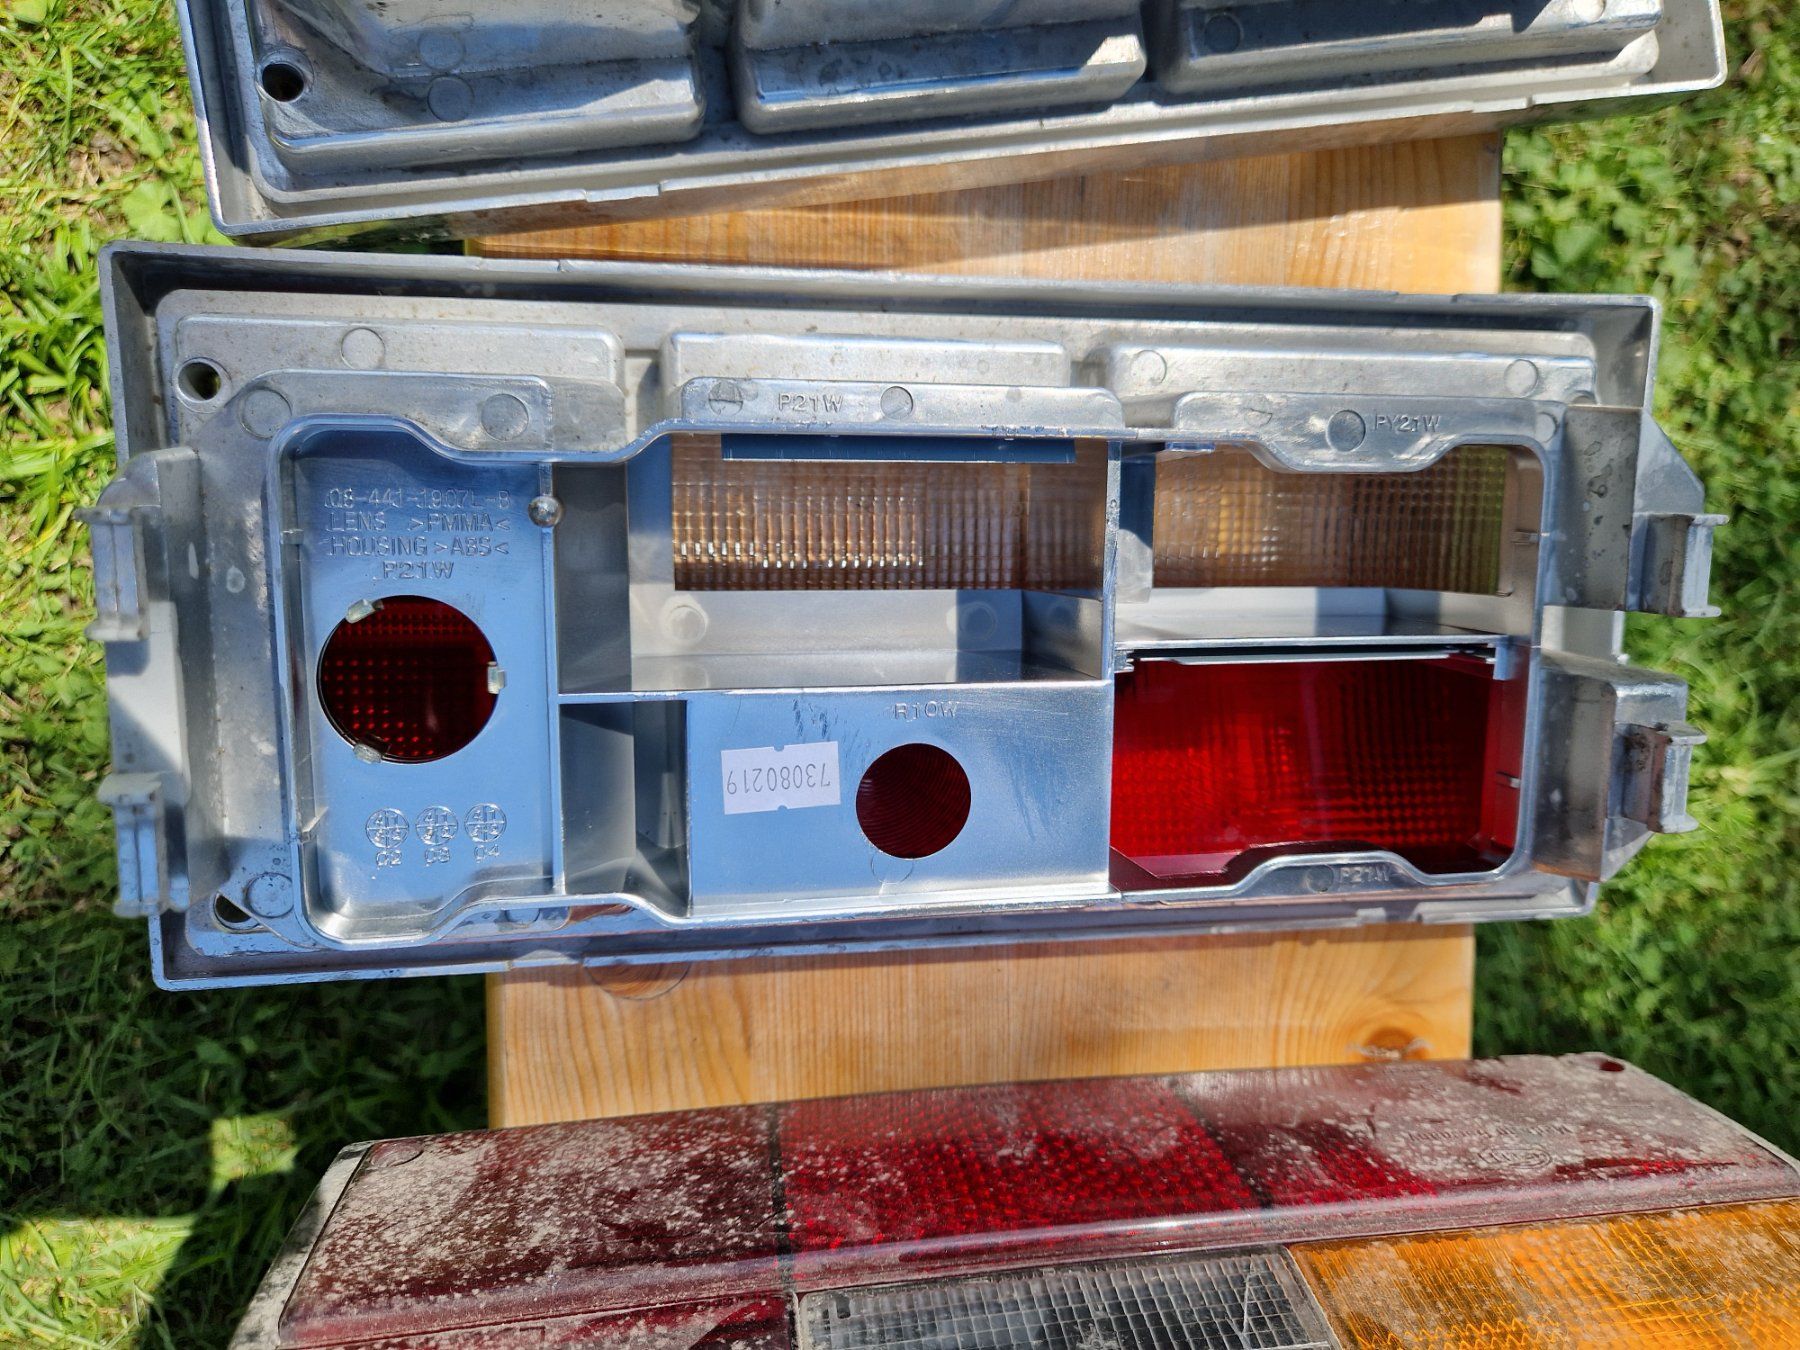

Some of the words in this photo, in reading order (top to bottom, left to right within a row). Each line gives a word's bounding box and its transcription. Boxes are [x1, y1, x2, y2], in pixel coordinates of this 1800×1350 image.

[778, 393, 844, 413] P21W
[1374, 412, 1441, 433] PY21W
[327, 511, 387, 532] LENS
[328, 536, 428, 556] HOUSING
[378, 560, 455, 580] P21W
[892, 700, 960, 720] R10W
[726, 762, 831, 795] 73080219
